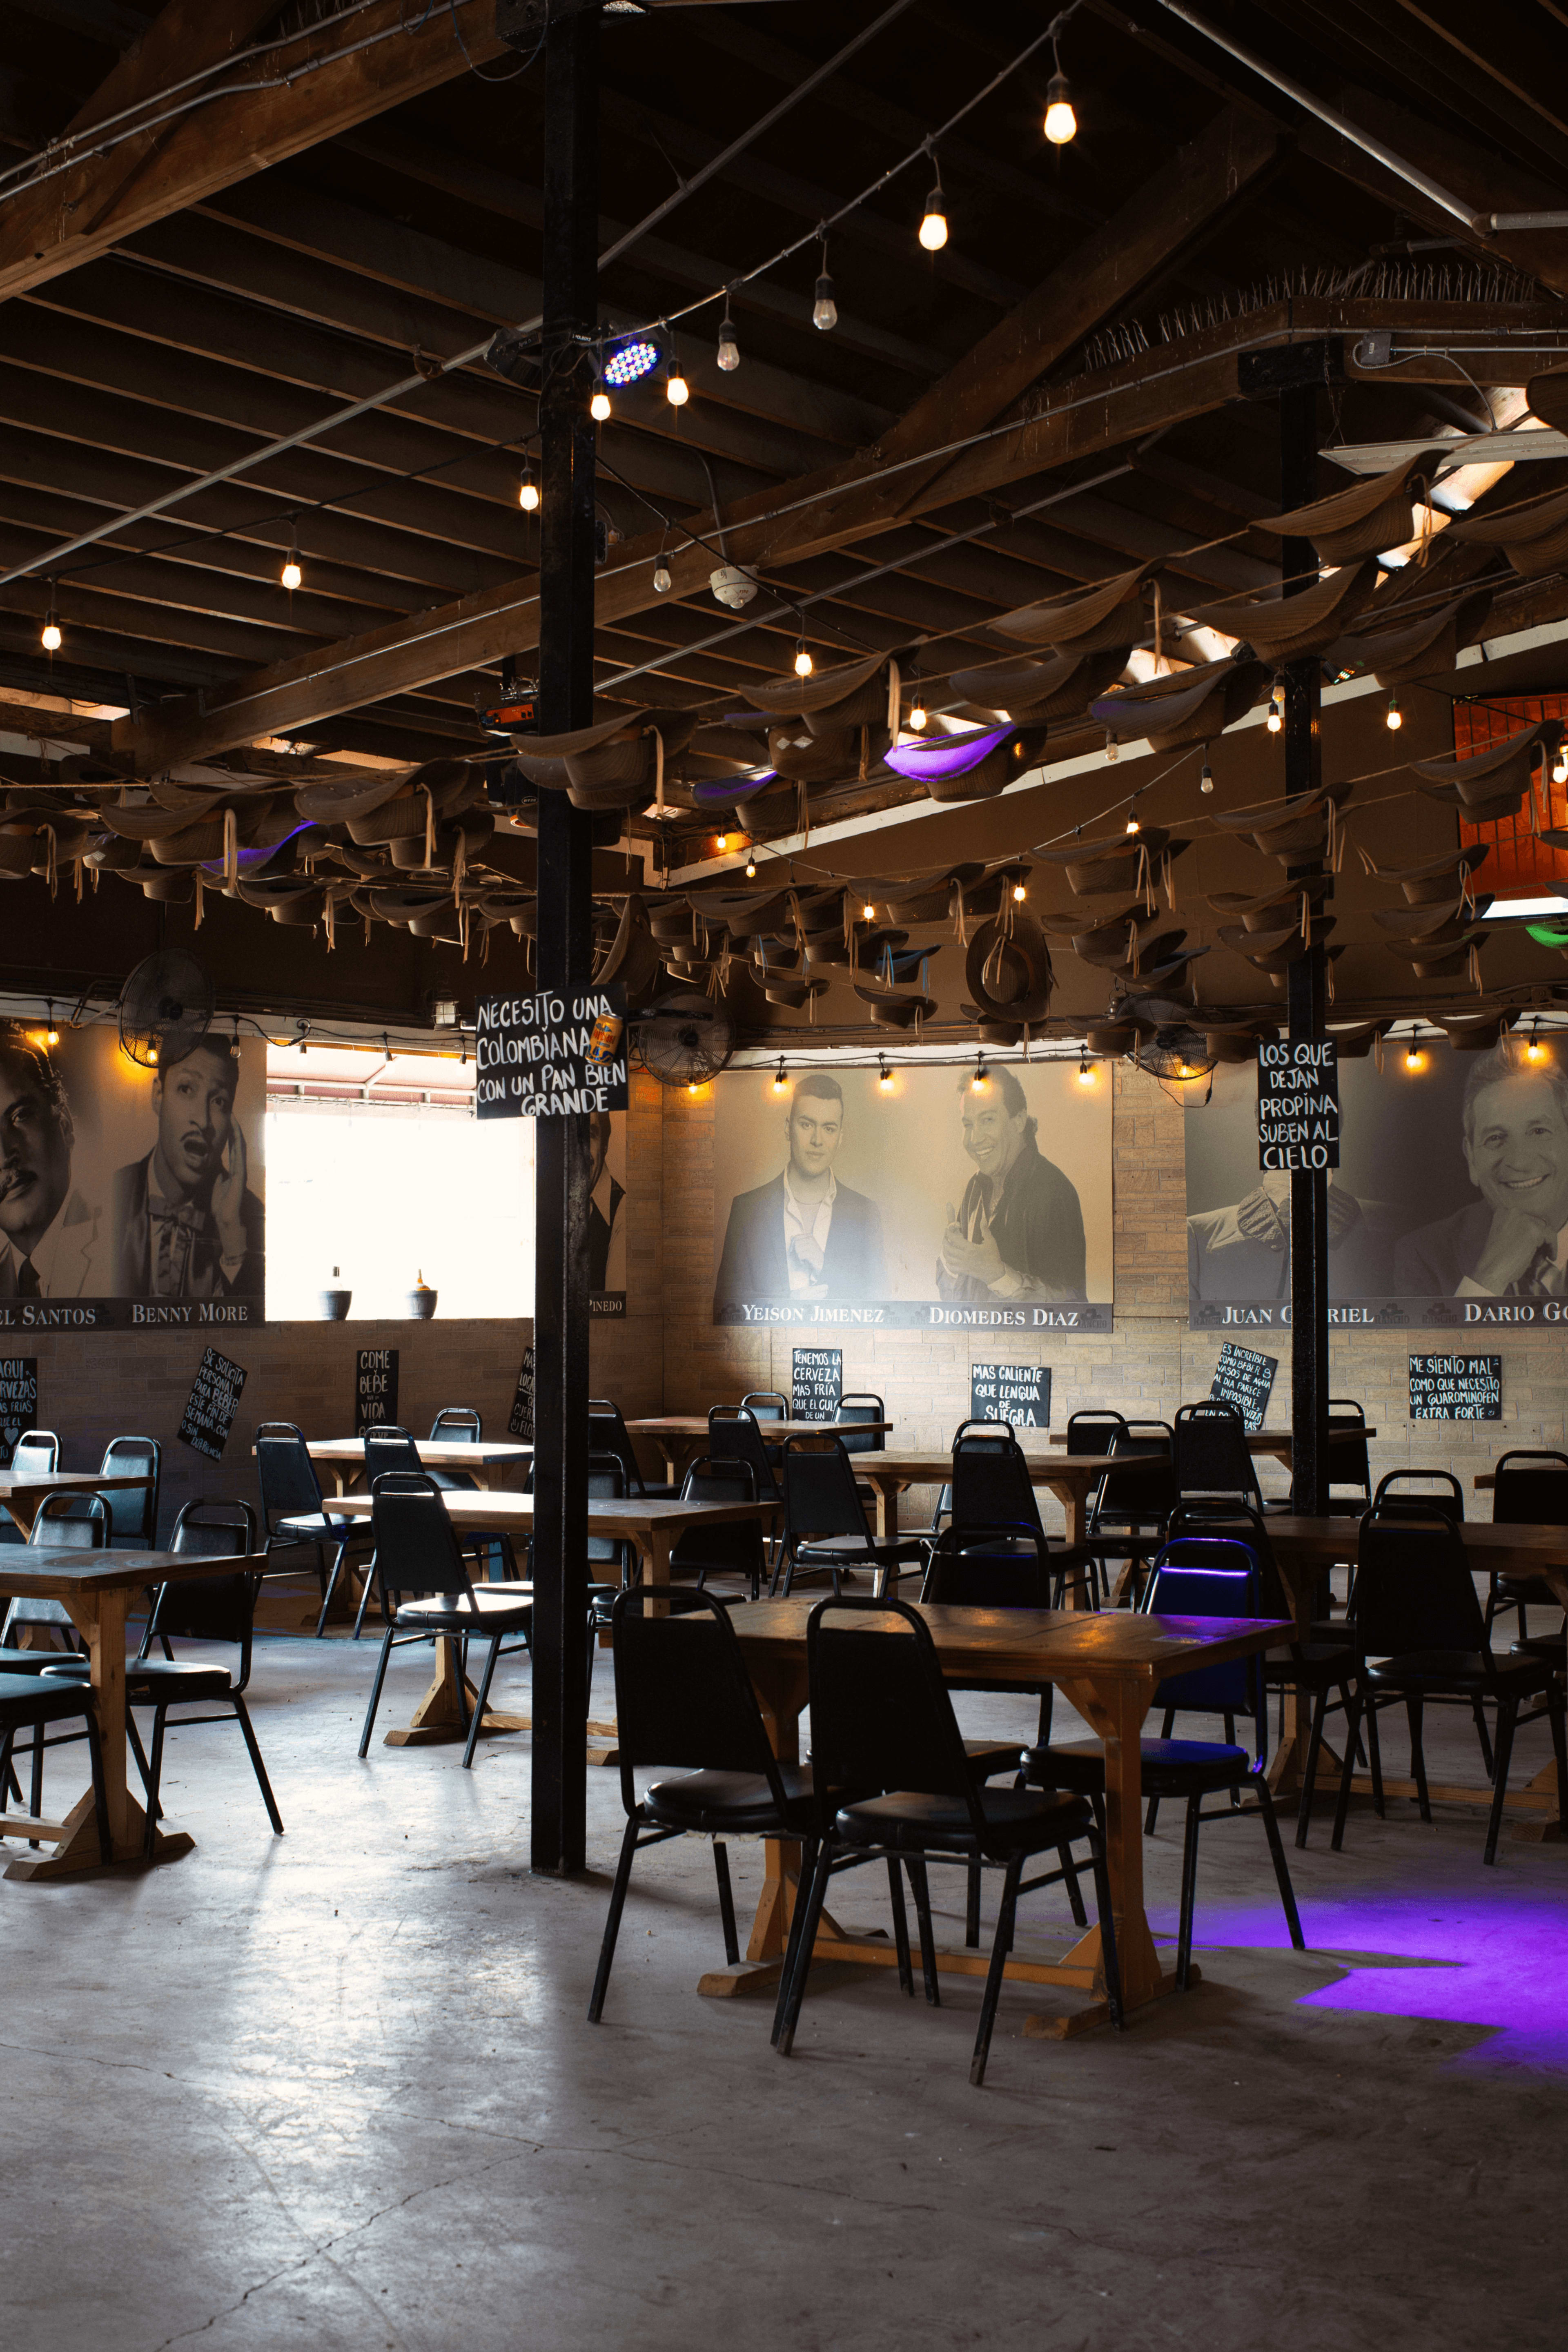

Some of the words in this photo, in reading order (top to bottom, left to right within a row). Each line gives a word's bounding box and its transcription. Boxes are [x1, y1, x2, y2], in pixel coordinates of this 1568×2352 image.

[477, 991, 564, 1031] NECESITO
[573, 995, 612, 1020] UNA
[477, 1025, 590, 1070] COLOMBIANA
[1260, 1044, 1290, 1067] LOS
[1294, 1042, 1334, 1066] QUE
[477, 1077, 506, 1102] CON
[512, 1073, 534, 1096] UN
[541, 1063, 575, 1091] PAN
[585, 1060, 626, 1086] BIEN
[1270, 1067, 1319, 1089] DEJAN
[521, 1087, 609, 1116] GRANDE
[1260, 1093, 1338, 1120] PROPINA
[1258, 1120, 1309, 1143] SUBEN
[1313, 1120, 1338, 1141] AL
[1263, 1145, 1327, 1169] CIELO
[22, 1305, 96, 1325] SANTOS
[132, 1305, 192, 1323] BENNY
[199, 1303, 248, 1321] MORE
[742, 1304, 804, 1321] YEISON
[810, 1305, 884, 1322] JIMENEZ
[929, 1307, 1025, 1325] DIOMEDES
[1032, 1308, 1079, 1326] DIAZ
[1222, 1306, 1273, 1324] JUAN
[1465, 1304, 1535, 1322] DARIO
[793, 1350, 829, 1365] TENEMOS
[832, 1353, 841, 1365] LA
[1223, 1343, 1231, 1355] ES
[205, 1348, 216, 1366] SE
[216, 1357, 243, 1385] SOLICITA
[361, 1350, 390, 1369] COME
[1219, 1354, 1236, 1366] COMO
[1237, 1361, 1261, 1375] BEBER
[1263, 1368, 1271, 1379] 8
[1410, 1356, 1424, 1372] ME
[1427, 1356, 1465, 1374] SIENTO
[1469, 1358, 1492, 1374] MAL
[199, 1366, 234, 1396] PERSONAL
[793, 1367, 840, 1382] CERVEZA
[973, 1365, 996, 1380] MAS
[999, 1366, 1043, 1383] CALIENTE
[1217, 1364, 1240, 1379] VASOS
[1243, 1373, 1252, 1382] DE
[1253, 1377, 1270, 1389] AGUA
[360, 1374, 388, 1394] BEBE
[793, 1384, 811, 1396] MAS
[975, 1384, 997, 1397] QUE
[999, 1385, 1040, 1401] LENGUA
[1214, 1374, 1221, 1383] AL
[1237, 1382, 1262, 1397] PARECE
[1410, 1378, 1435, 1392] COMO
[1437, 1378, 1455, 1391] QUE
[1458, 1376, 1499, 1391] NECESITO
[194, 1378, 211, 1398] PARA
[212, 1388, 238, 1415] BEBER
[793, 1399, 808, 1410] QUE
[810, 1399, 817, 1410] EL
[999, 1400, 1011, 1409] DE
[1410, 1394, 1423, 1405] UN
[189, 1393, 205, 1410] ESTE
[207, 1404, 219, 1419] FIN
[219, 1413, 229, 1424] DE
[361, 1402, 386, 1419] VIDA
[805, 1411, 814, 1419] DE
[815, 1412, 825, 1420] UN
[1416, 1407, 1449, 1419] EXTRA
[1455, 1404, 1485, 1419] FORTE
[12, 1417, 22, 1426] EL
[182, 1420, 187, 1430] O
[186, 1423, 199, 1436] SIN
[216, 1425, 229, 1439] CON
